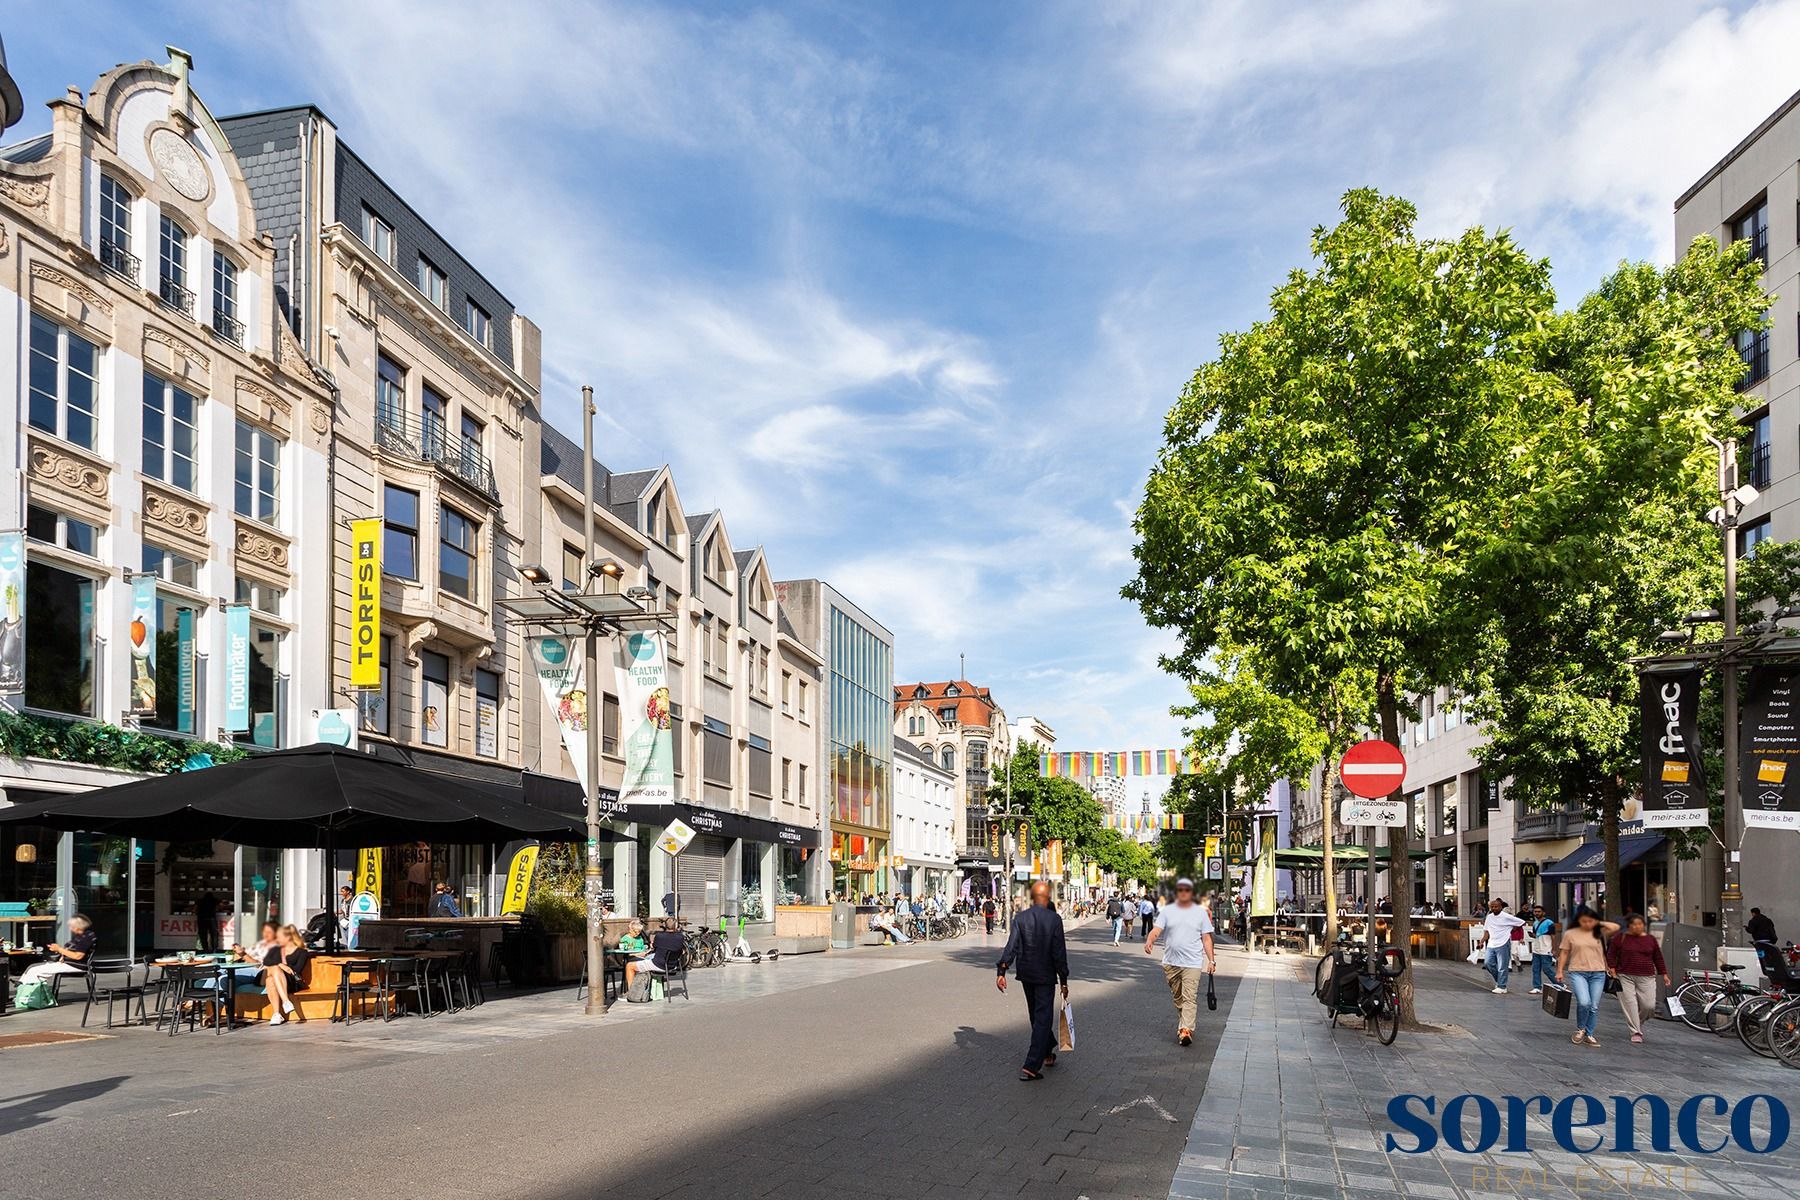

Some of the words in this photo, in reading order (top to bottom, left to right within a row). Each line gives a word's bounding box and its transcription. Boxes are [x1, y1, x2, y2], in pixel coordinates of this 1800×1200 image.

[361, 543, 371, 558] .be
[358, 562, 374, 665] TORFS
[229, 632, 246, 712] Foodmaker
[540, 668, 574, 679] HEALTHY
[628, 665, 663, 676] HEALTHY
[637, 676, 658, 687] FOOD
[1772, 688, 1791, 696] Vinyl
[1658, 682, 1686, 755] fnac
[1758, 724, 1795, 733] Computers
[1753, 736, 1797, 744] Smartphones
[1759, 763, 1787, 772] fnac
[582, 797, 628, 814] CISTMAS
[691, 815, 723, 829] CHRISTMAS
[1651, 812, 1701, 822] meir-as.be
[1751, 813, 1794, 823] meir-as.be
[779, 831, 802, 842] CHRISTMAS
[990, 823, 1000, 858] Orange
[1017, 823, 1029, 858] Orange
[513, 854, 530, 902] TORFS
